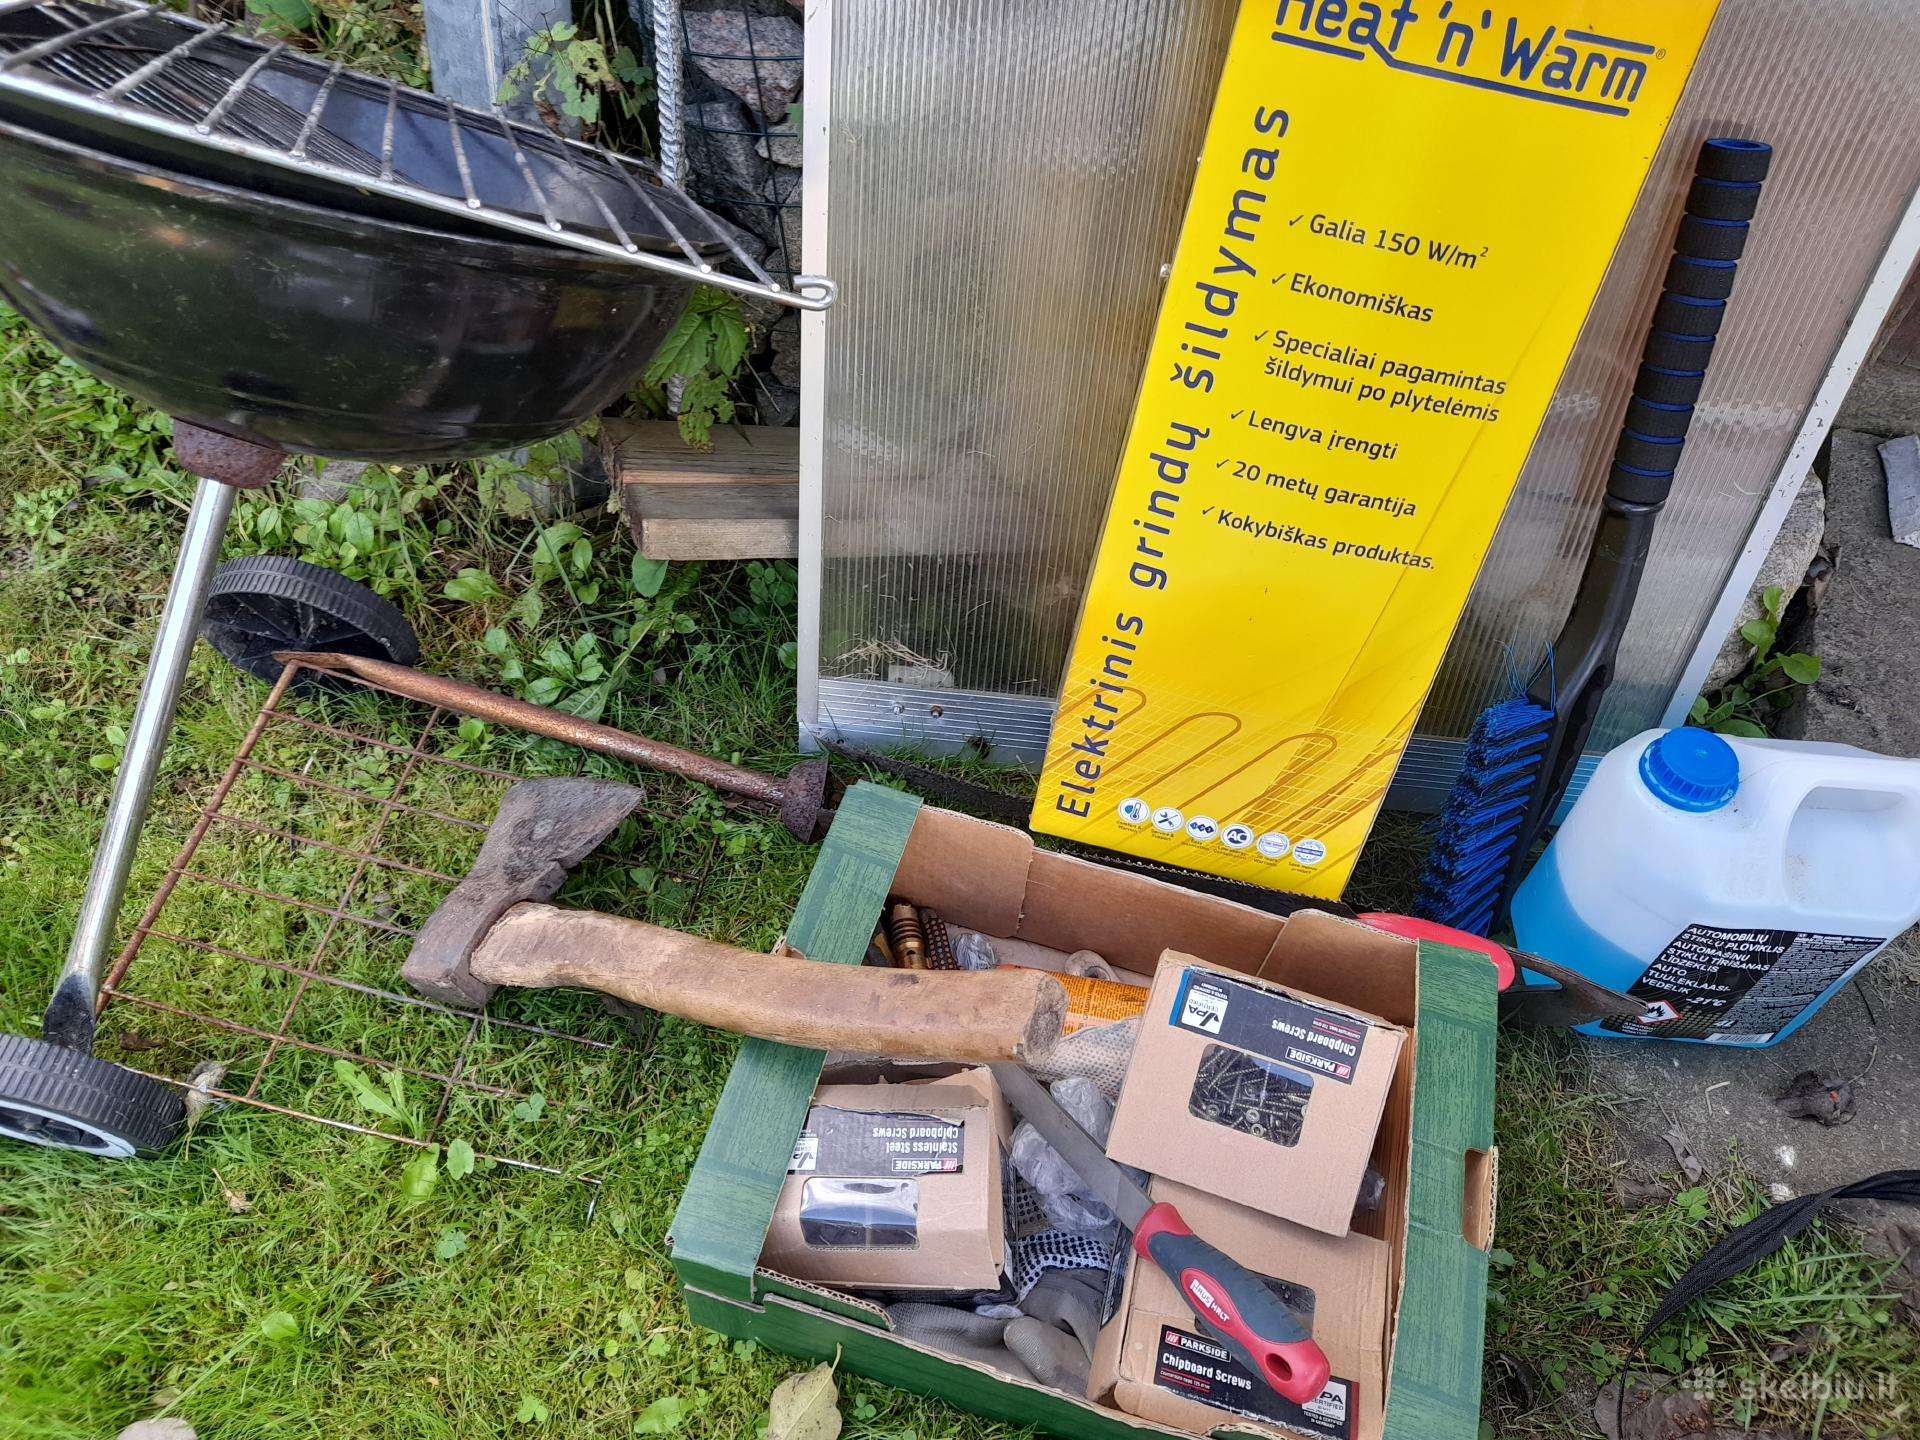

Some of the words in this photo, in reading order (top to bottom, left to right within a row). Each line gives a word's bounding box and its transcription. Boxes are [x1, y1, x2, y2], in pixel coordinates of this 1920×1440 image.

[1309, 213, 1366, 245] Galia
[1373, 229, 1421, 256] 150
[1290, 272, 1434, 322] Ekonomiškas
[1272, 330, 1377, 370] Specialiai
[1380, 359, 1507, 395] pagamintas
[1264, 356, 1352, 394] šildymui
[1357, 382, 1386, 402] po
[1389, 388, 1500, 422] plytelėmis
[1248, 410, 1323, 443] Lengva
[1326, 430, 1398, 461] įrengti
[1056, 612, 1143, 818] Elektrinis
[1129, 421, 1210, 590] grindų
[1170, 105, 1289, 393] šildymas
[1232, 460, 1261, 481] 20
[1265, 471, 1319, 497] metų
[1324, 485, 1417, 518] garantija
[1217, 508, 1328, 549] Kokybiškas
[1332, 538, 1435, 570] produktas.
[1681, 933, 1724, 948] STIKLŲ
[1725, 941, 1785, 954] PLOVIKLIS
[1687, 927, 1769, 943] AUTOMOBILIŲ
[1666, 948, 1709, 961] STIKLU
[1652, 963, 1688, 976] AUTO
[1642, 977, 1692, 995] VEDELIK
[1272, 1019, 1306, 1040] Screws
[1307, 1032, 1356, 1057] Chipboard
[1289, 1049, 1337, 1071] PARKSIDE
[873, 1127, 907, 1138] Screws
[908, 1126, 959, 1138] Chipboard
[886, 1142, 912, 1153] Steel
[913, 1141, 958, 1154] Stainless
[895, 1160, 942, 1170] PARKSIDE
[1181, 1338, 1228, 1360] PARKSIDE
[1162, 1352, 1213, 1377] Chipboard
[1215, 1370, 1252, 1390] Screws
